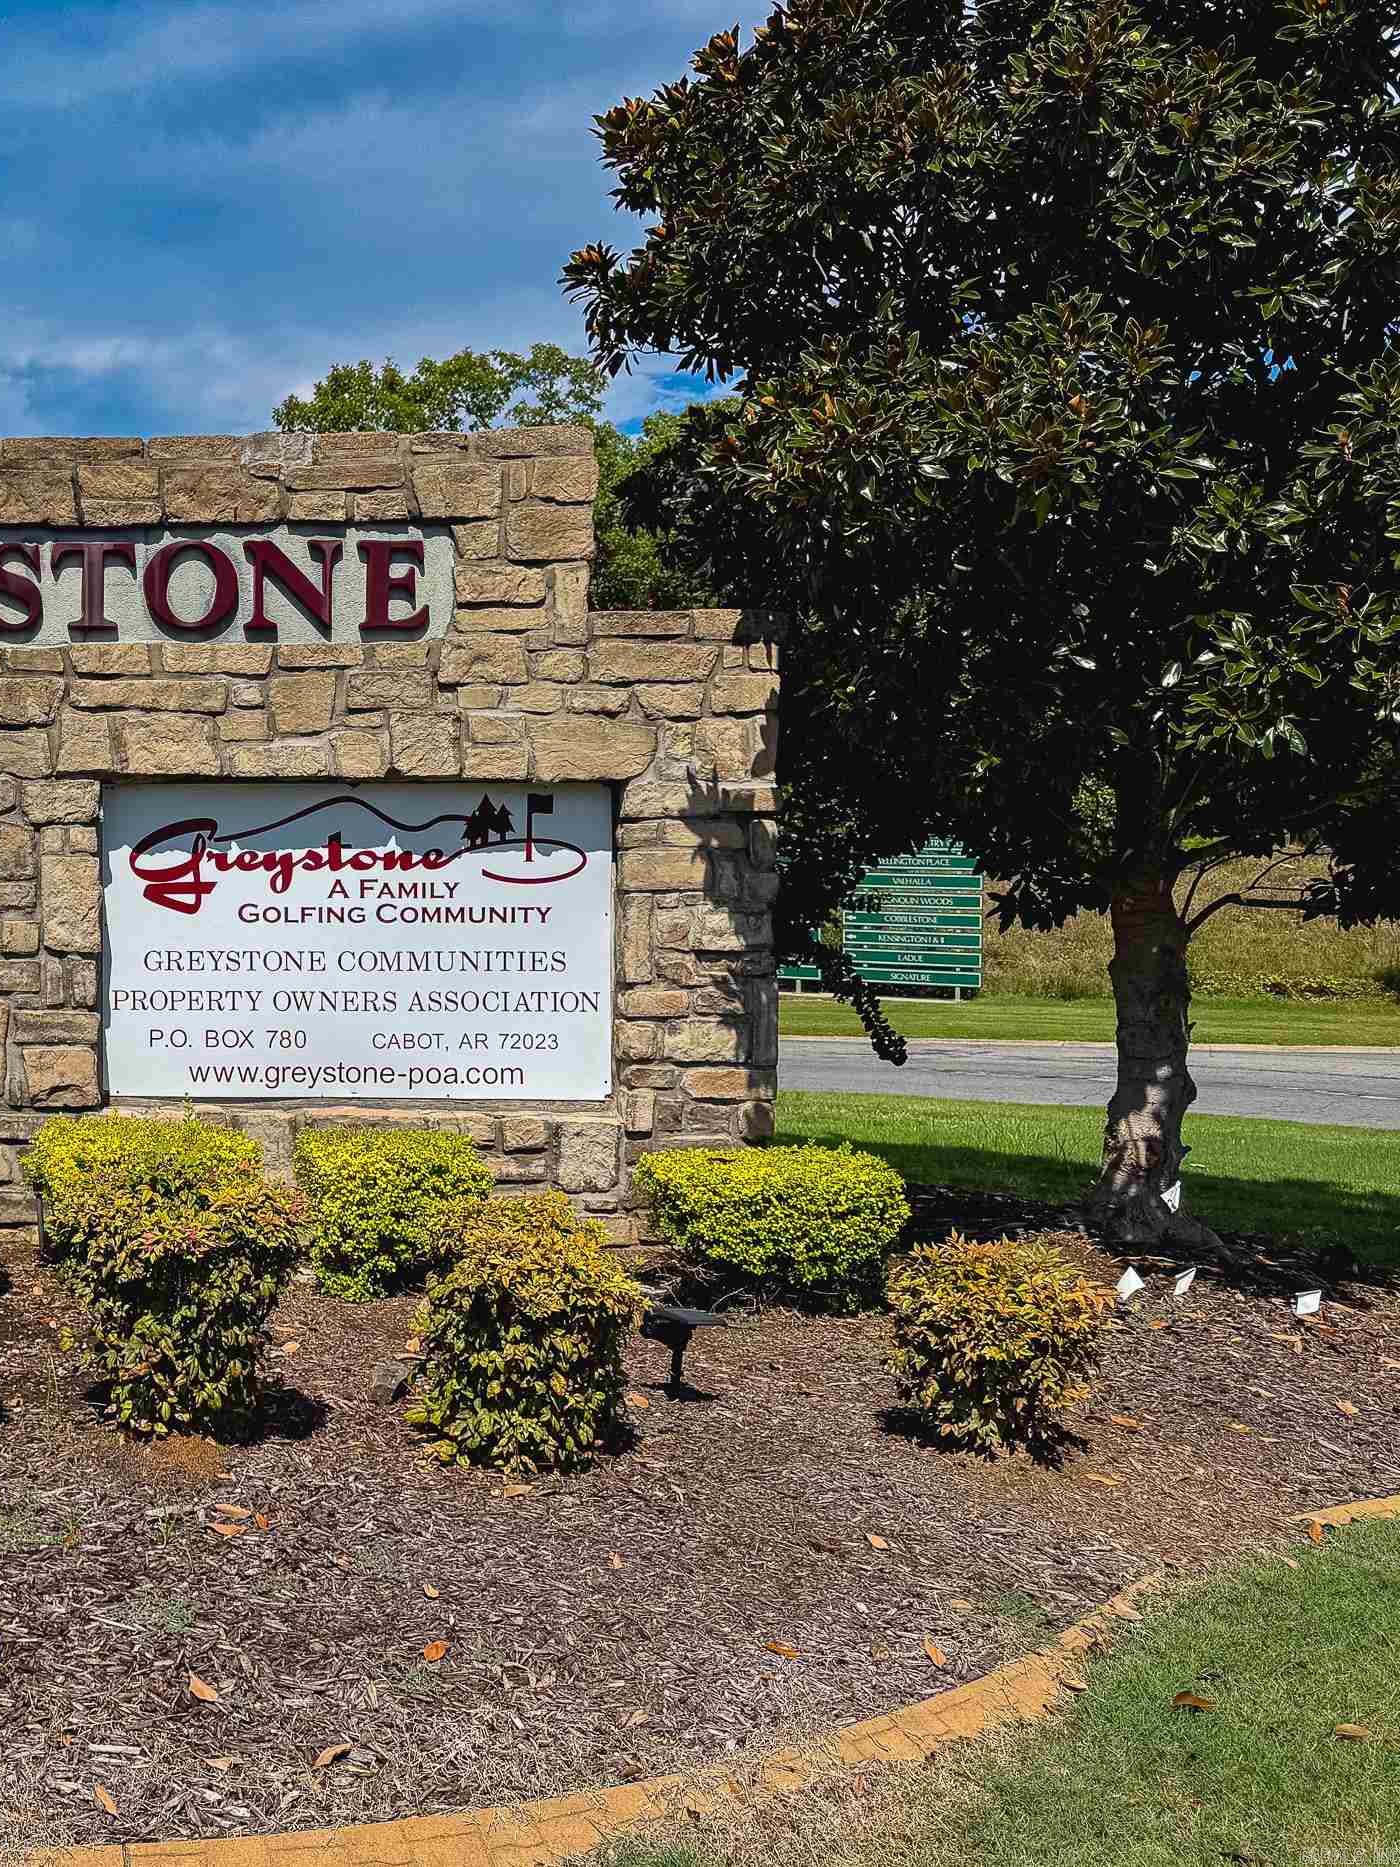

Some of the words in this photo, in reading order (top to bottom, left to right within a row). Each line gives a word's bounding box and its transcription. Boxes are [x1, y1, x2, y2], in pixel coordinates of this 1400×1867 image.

[129, 817, 456, 916] Greystone
[926, 858, 952, 867] PLACE
[327, 879, 350, 899] A
[920, 897, 953, 906] WOODS
[143, 950, 327, 972] GREYSTONE
[336, 950, 568, 973] COMMUNITIES
[890, 973, 932, 982] SIGNATURE
[111, 989, 263, 1012] PROPERTY
[272, 990, 398, 1013] OWNERS
[407, 990, 601, 1014] ASSOCIATION
[149, 1029, 193, 1049] P.O.
[205, 1029, 255, 1049] BOX
[266, 1029, 308, 1050] 780
[371, 1032, 450, 1052] CABOT,
[458, 1032, 489, 1051] AR
[498, 1032, 560, 1051] 72023
[188, 1062, 525, 1090] www.greystone-poa.com
